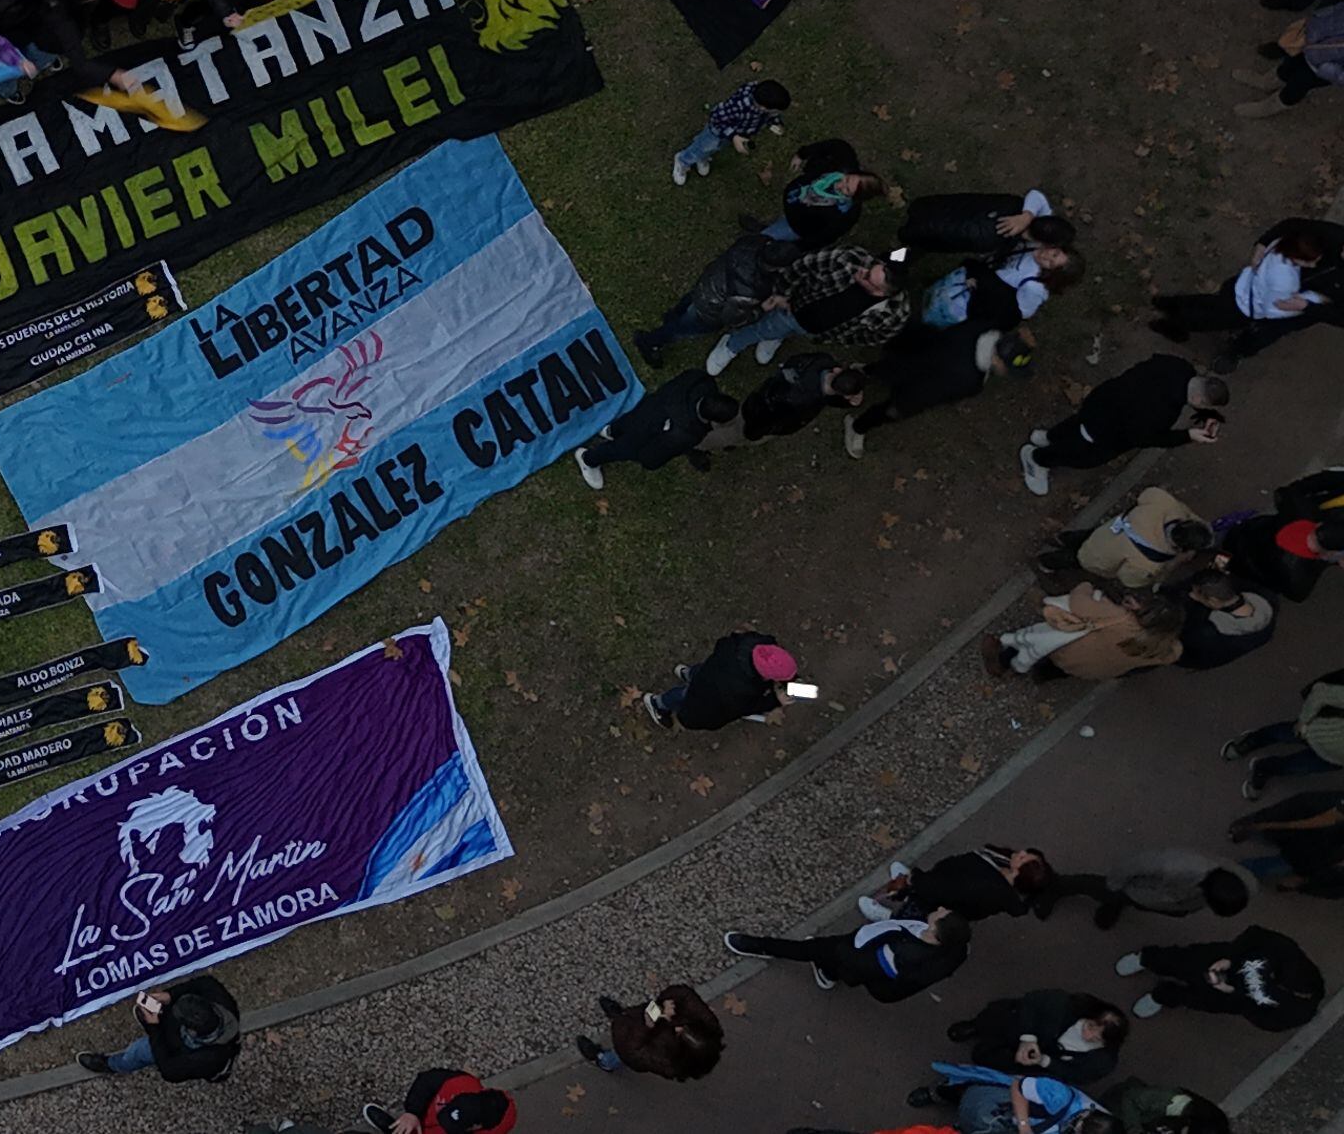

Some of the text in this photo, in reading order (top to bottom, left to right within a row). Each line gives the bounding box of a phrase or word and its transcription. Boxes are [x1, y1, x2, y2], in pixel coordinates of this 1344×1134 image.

[246, 42, 468, 188] MILEI
[5, 319, 54, 347] DUEÑOS
[54, 313, 69, 328] DE
[69, 306, 87, 321] LA
[188, 300, 243, 343] LA
[197, 205, 438, 381] LIBERTAD
[286, 265, 425, 366] AVANZA
[29, 322, 114, 367] CIUDAD CELINA
[201, 326, 629, 630] GONZALEZ CATAN
[16, 655, 86, 690] ALDO BONZI
[22, 737, 73, 765] MADERO
[53, 902, 117, 976] La
[202, 834, 330, 905] Martin
[74, 881, 341, 999] LOMAS DE ZAMORA
